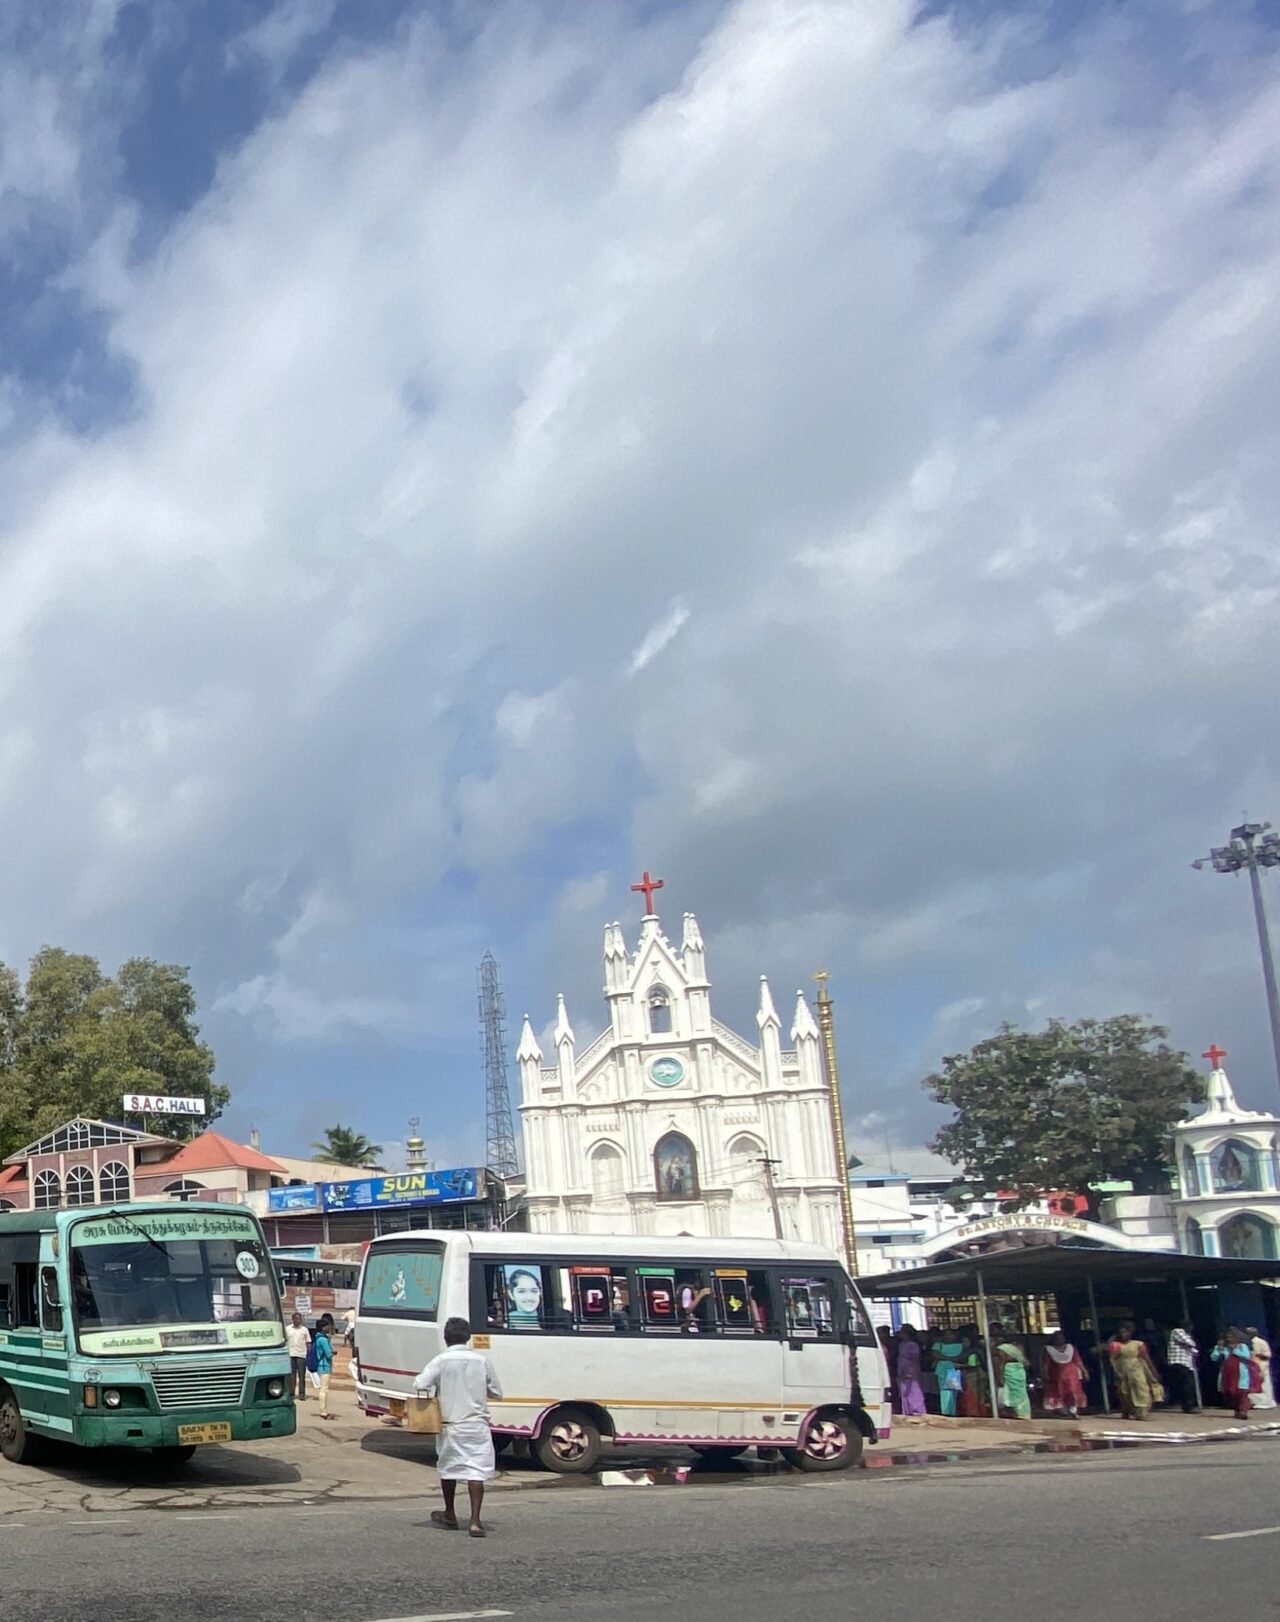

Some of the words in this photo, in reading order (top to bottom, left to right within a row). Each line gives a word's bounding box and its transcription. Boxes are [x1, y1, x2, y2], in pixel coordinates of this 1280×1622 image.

[170, 1099, 201, 1113] HALL
[383, 1175, 426, 1192] SUN
[1035, 1216, 1088, 1231] CHURCH
[239, 1257, 256, 1273] 303
